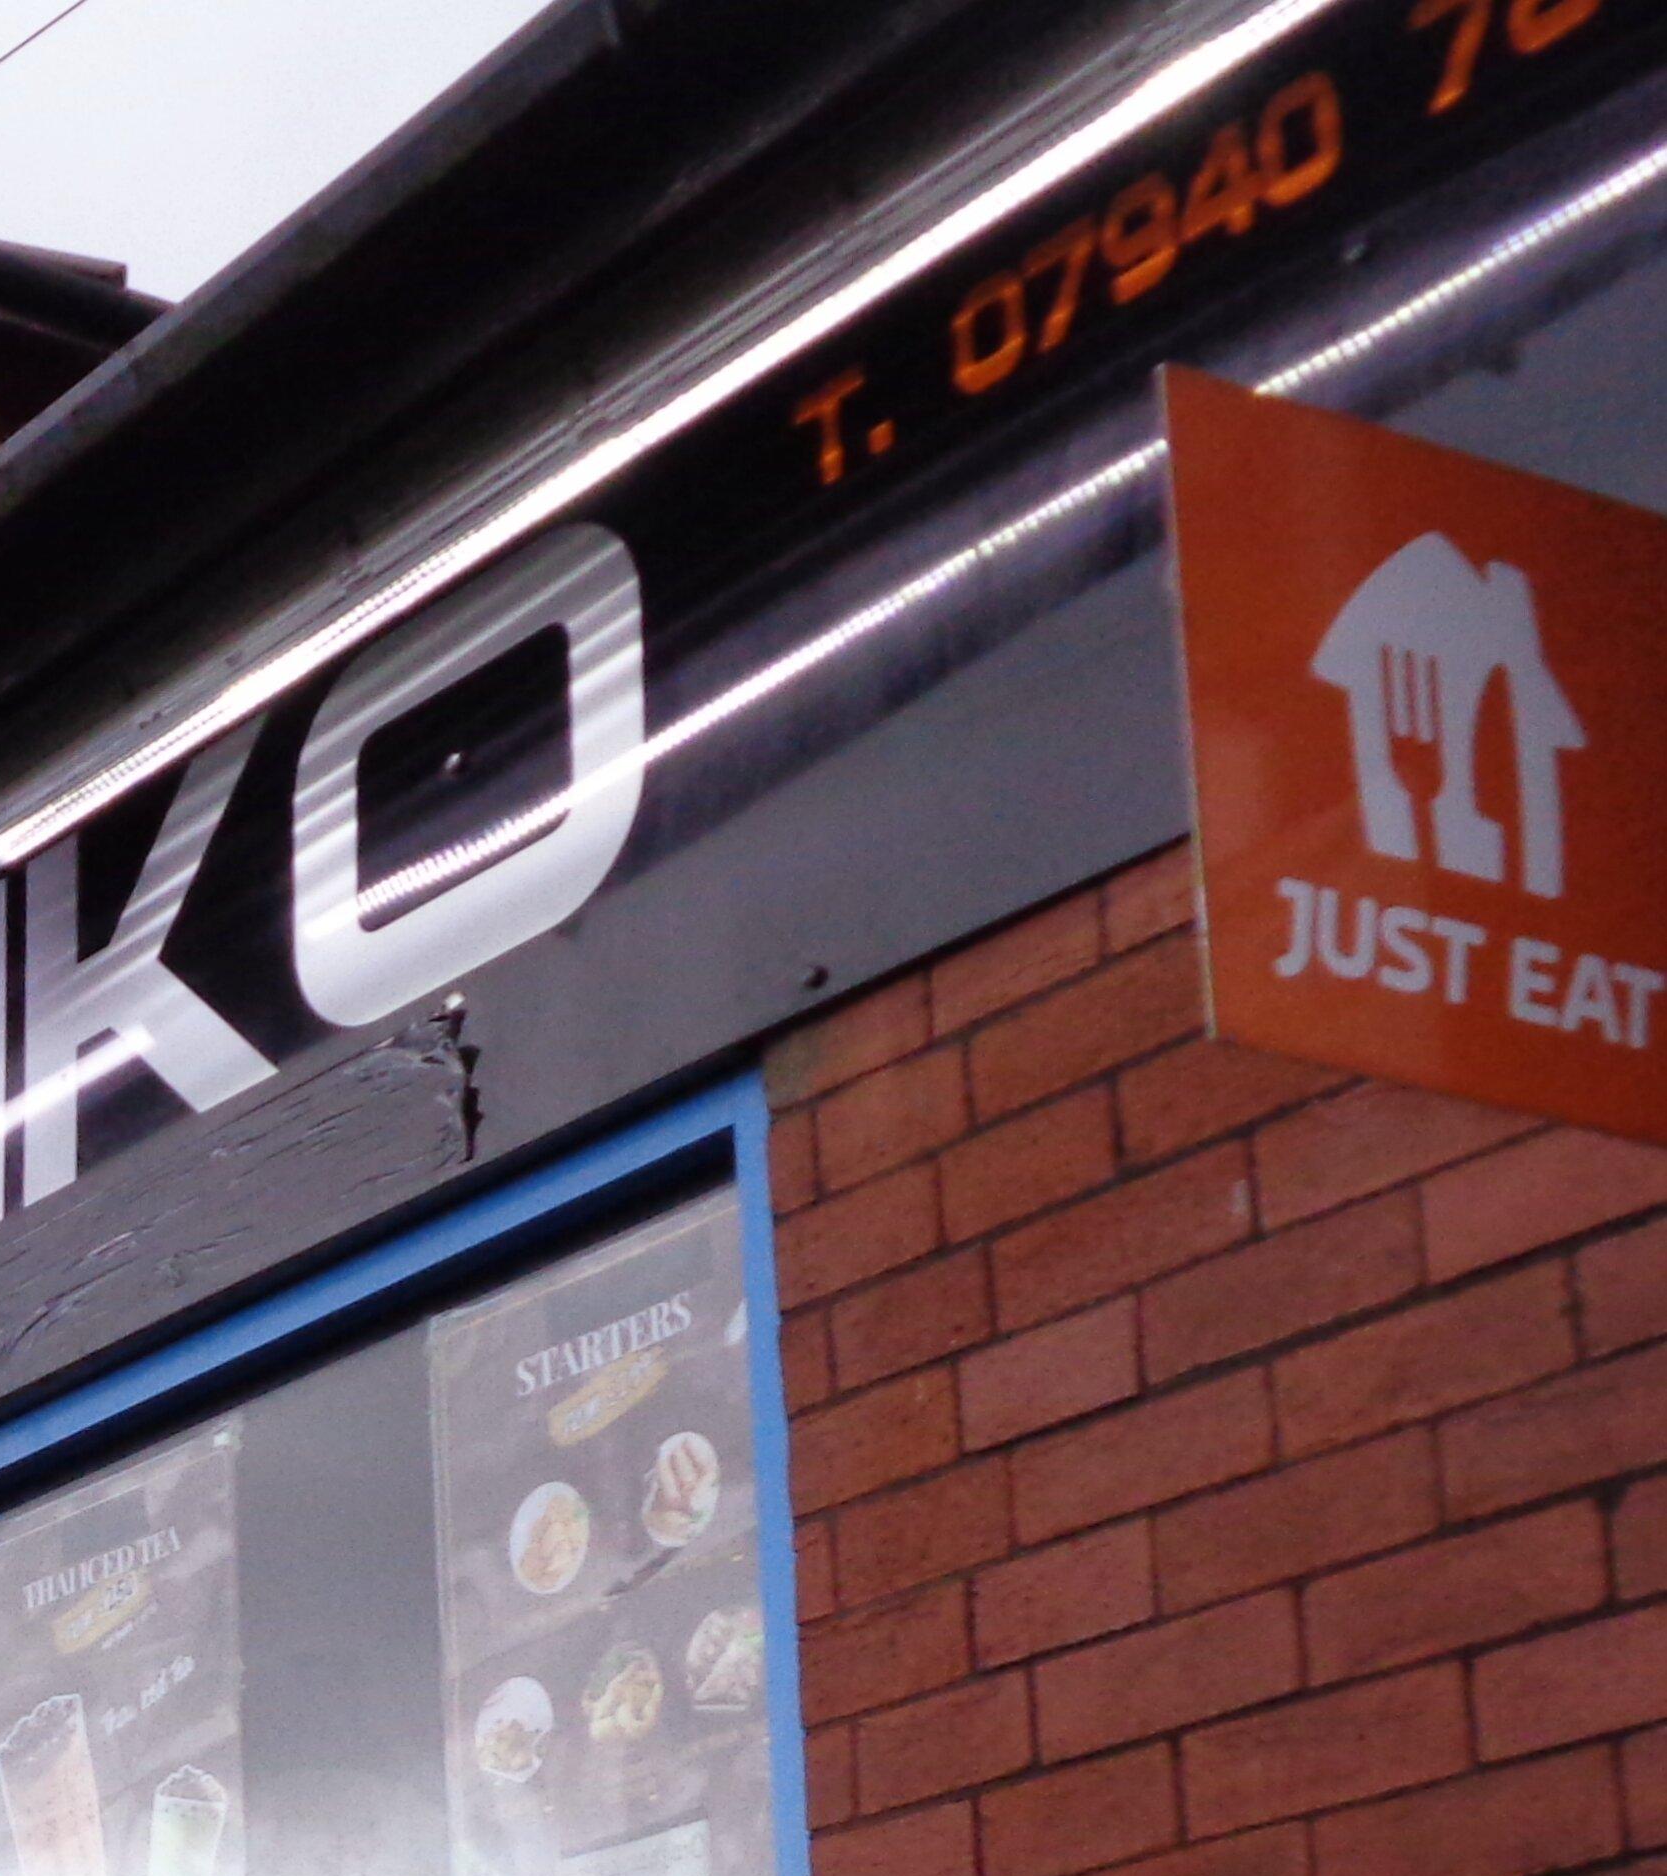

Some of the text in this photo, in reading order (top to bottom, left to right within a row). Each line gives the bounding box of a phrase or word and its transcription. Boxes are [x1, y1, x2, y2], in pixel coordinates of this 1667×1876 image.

[793, 368, 894, 485] T.
[950, 72, 1342, 393] 07940
[1274, 878, 1665, 1048] JUST EAT
[517, 1291, 692, 1396] STARTERS
[22, 1566, 76, 1609] THAI
[78, 1545, 136, 1590] ICED
[134, 1525, 182, 1566] TEA
